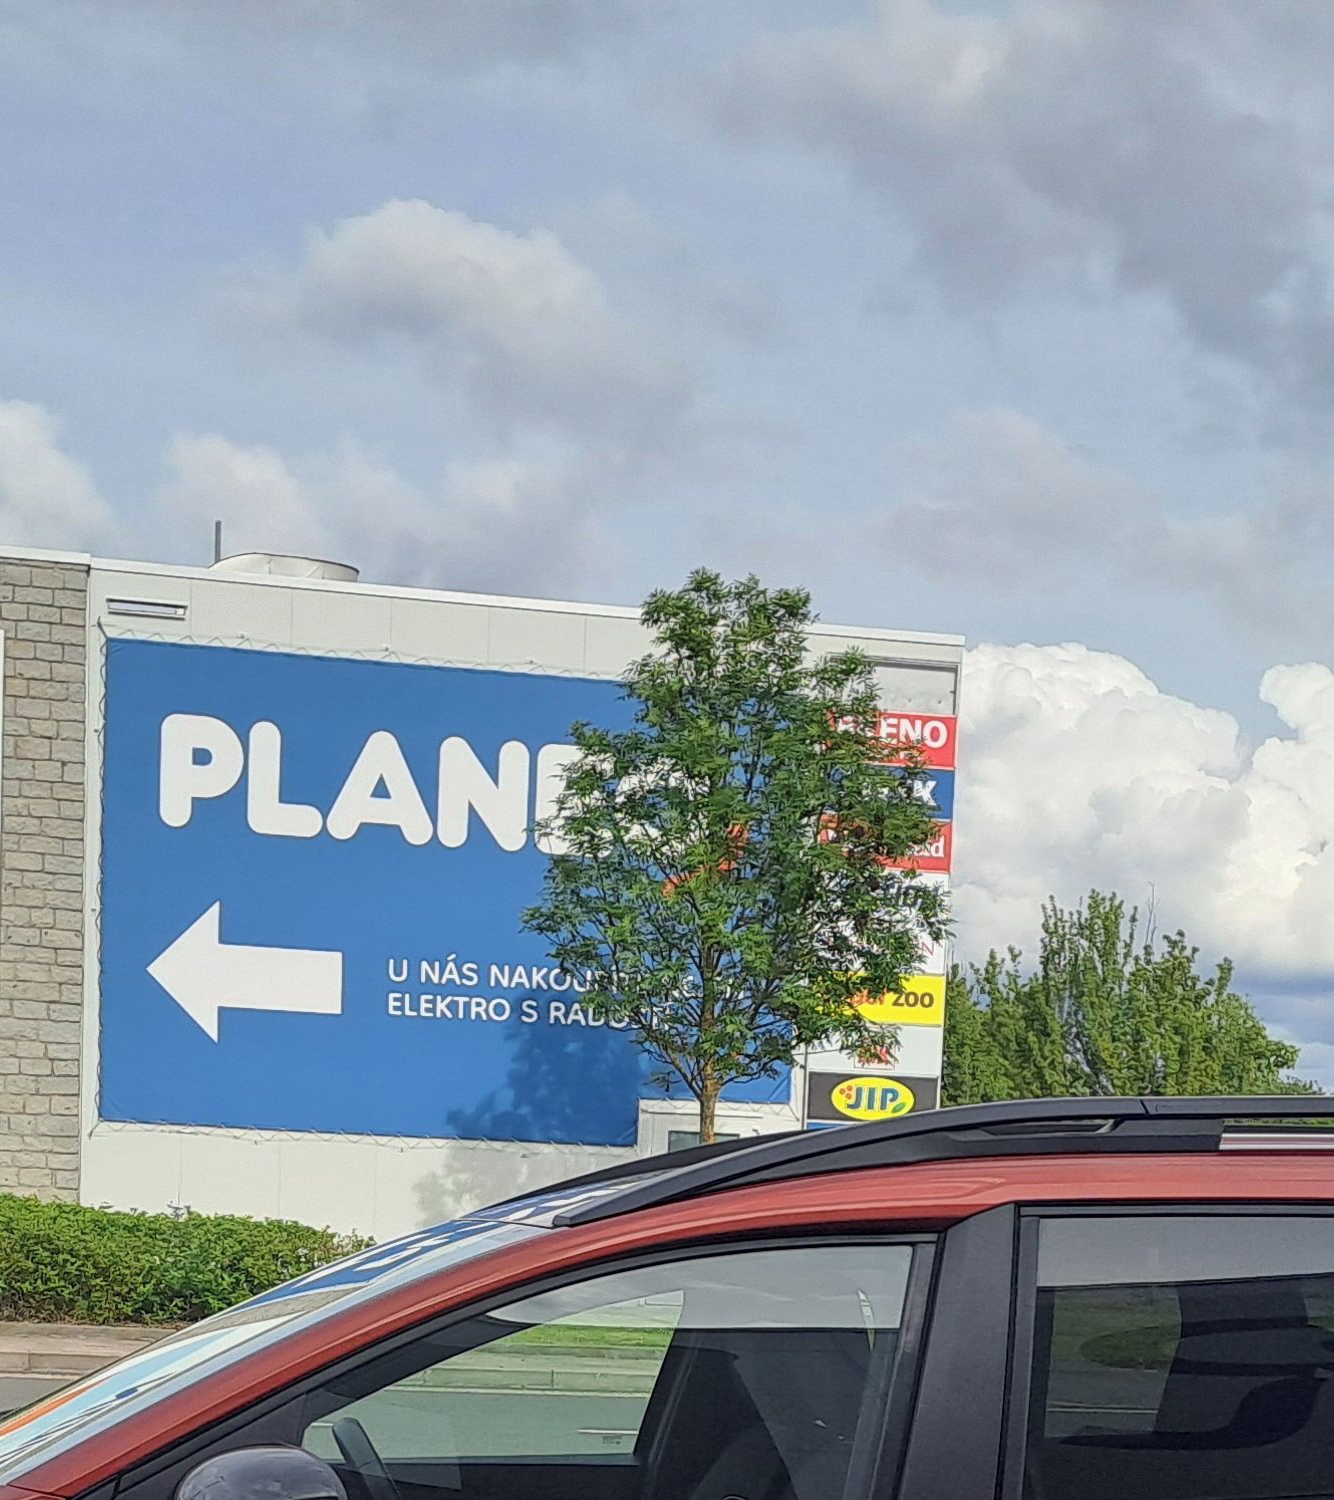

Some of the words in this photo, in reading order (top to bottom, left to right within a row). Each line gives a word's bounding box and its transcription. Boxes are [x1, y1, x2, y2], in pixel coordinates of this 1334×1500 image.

[388, 958, 408, 982] U
[420, 954, 479, 987] NÁS
[388, 993, 511, 1022] ELEKTRO
[521, 1000, 539, 1023] S
[847, 1086, 900, 1111] JIP
